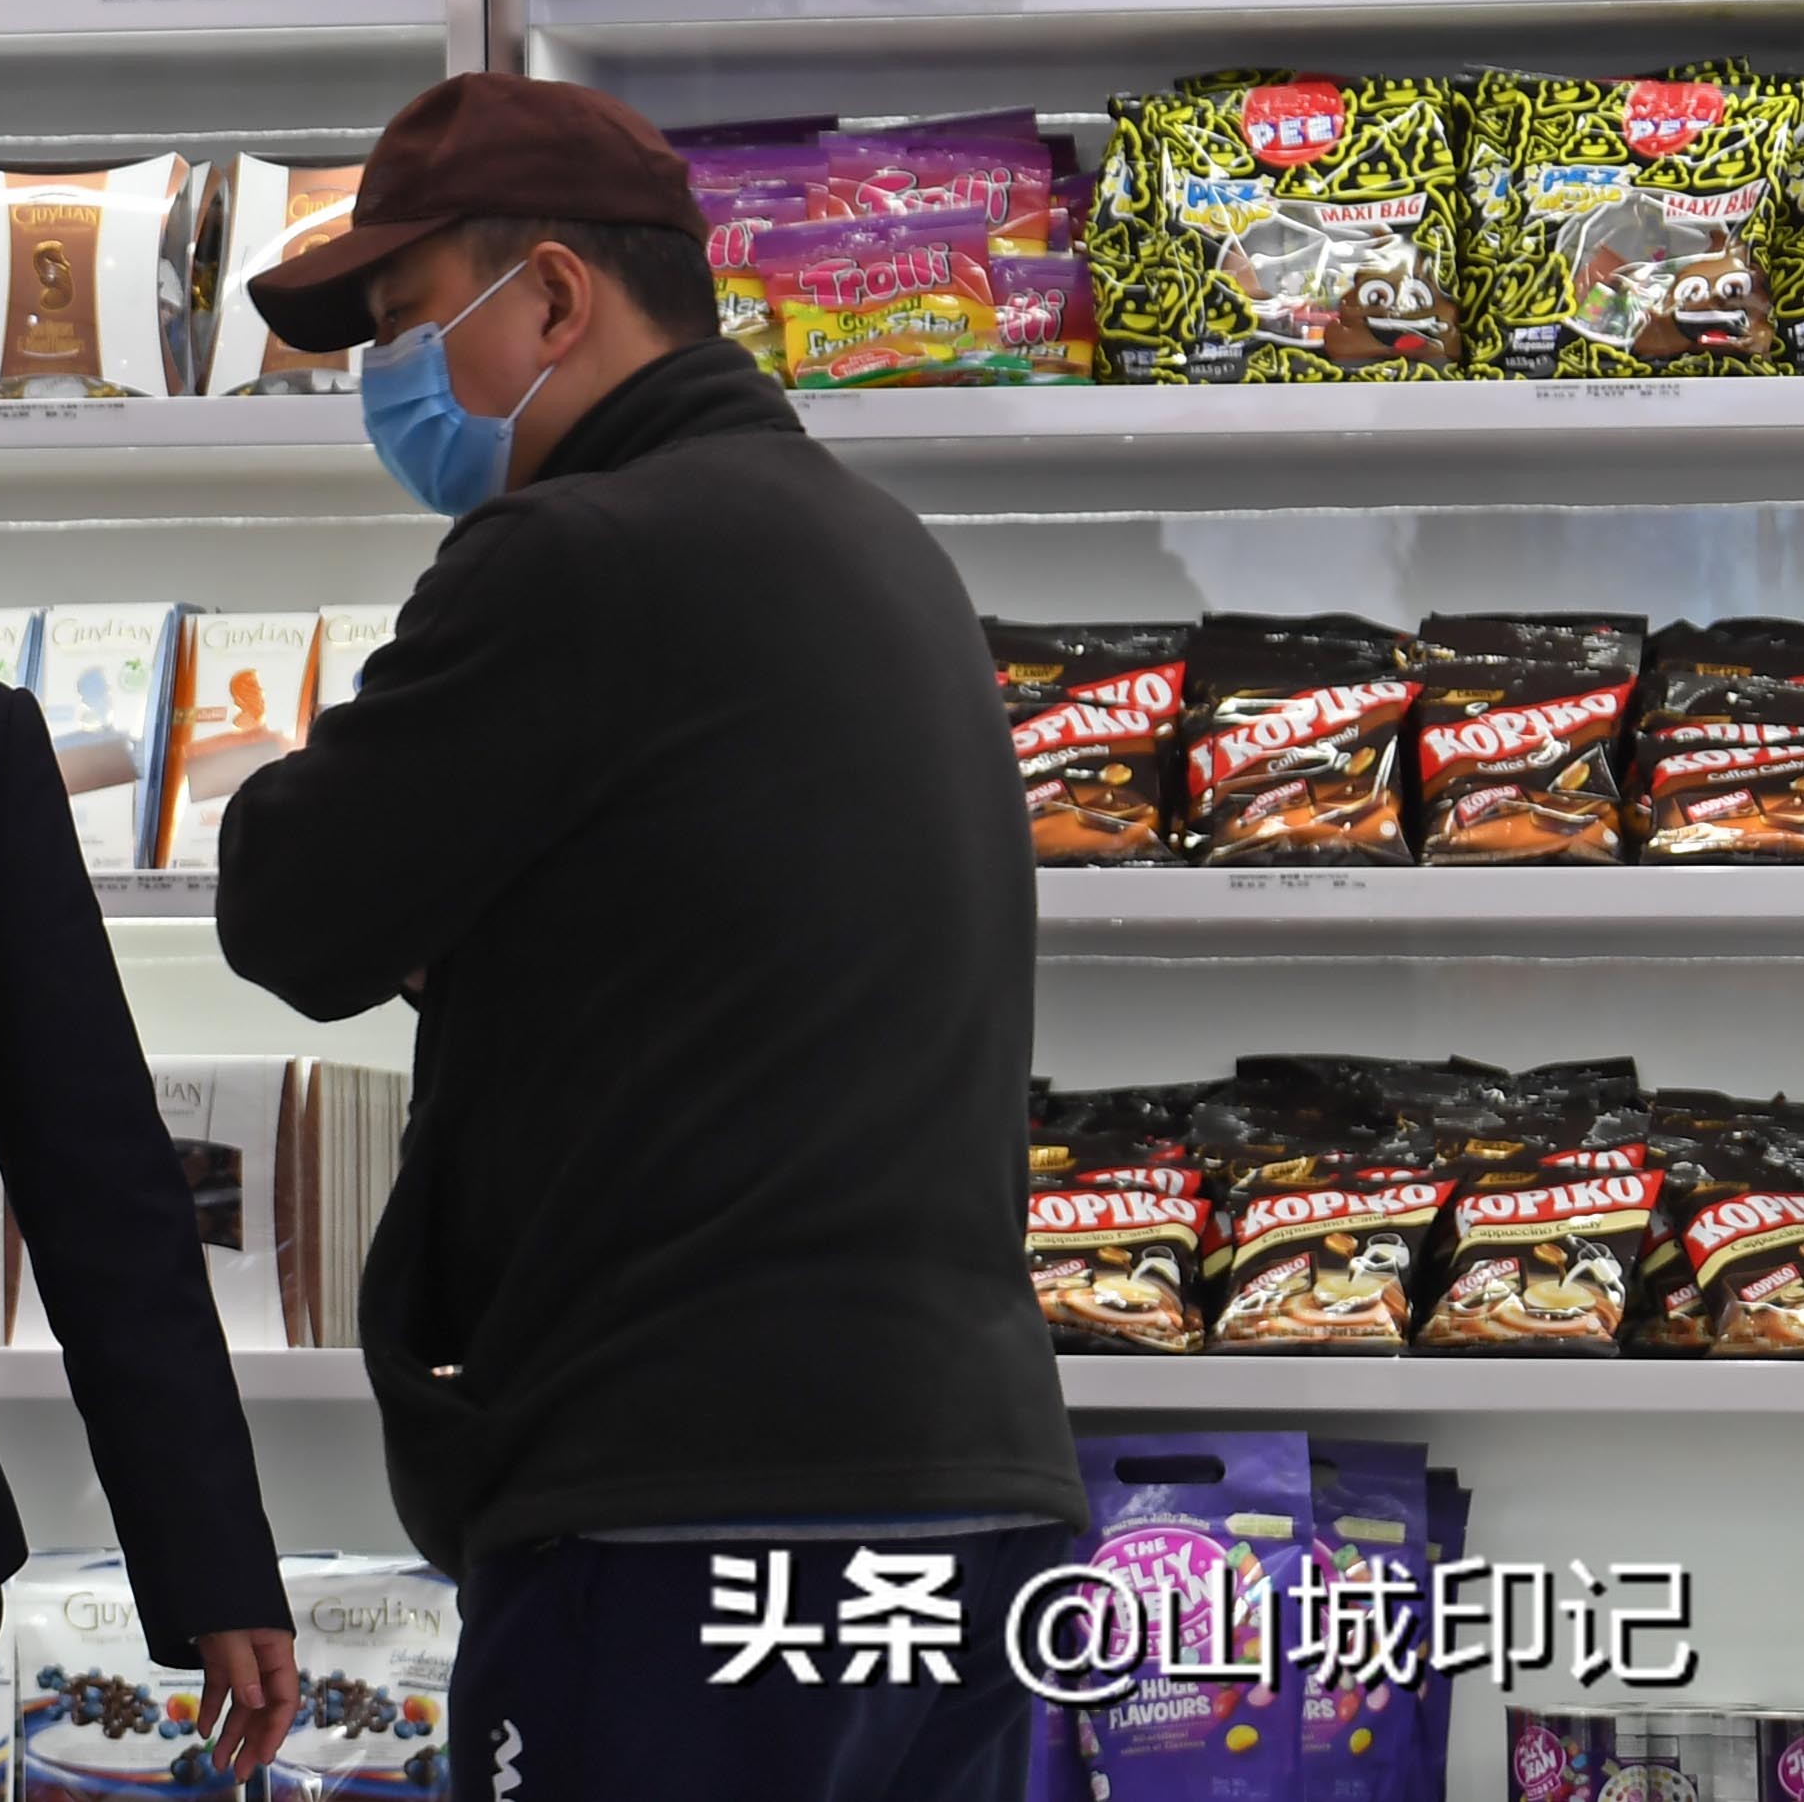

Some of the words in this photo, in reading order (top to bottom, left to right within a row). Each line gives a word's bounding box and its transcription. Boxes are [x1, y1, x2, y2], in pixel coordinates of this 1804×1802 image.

[1249, 116, 1334, 148] PEZ
[1321, 206, 1372, 224] MAXI
[1380, 197, 1421, 218] BAG
[1667, 196, 1720, 217] MAXI
[1725, 188, 1756, 214] BAG
[800, 243, 950, 305] Trolli
[1225, 681, 1408, 765] KOPIKO
[1426, 694, 1616, 762] KOPIKO
[1477, 759, 1525, 773] Coffee
[1707, 768, 1757, 783] Coffee
[1461, 786, 1516, 815] KOPIKO
[1691, 791, 1748, 817] KOPIKO
[1241, 1182, 1437, 1234] KOPIKO
[1456, 1174, 1644, 1236] KOPIKO
[1032, 1229, 1115, 1245] Cappuccino
[1117, 1226, 1162, 1240] Candy
[1263, 1217, 1345, 1244] Cappuccino
[1468, 1224, 1551, 1239] Cappuccino
[1742, 1267, 1796, 1301] KOPIKO
[1124, 1537, 1167, 1557] THE
[1109, 1695, 1211, 1731] FLAVOURS
